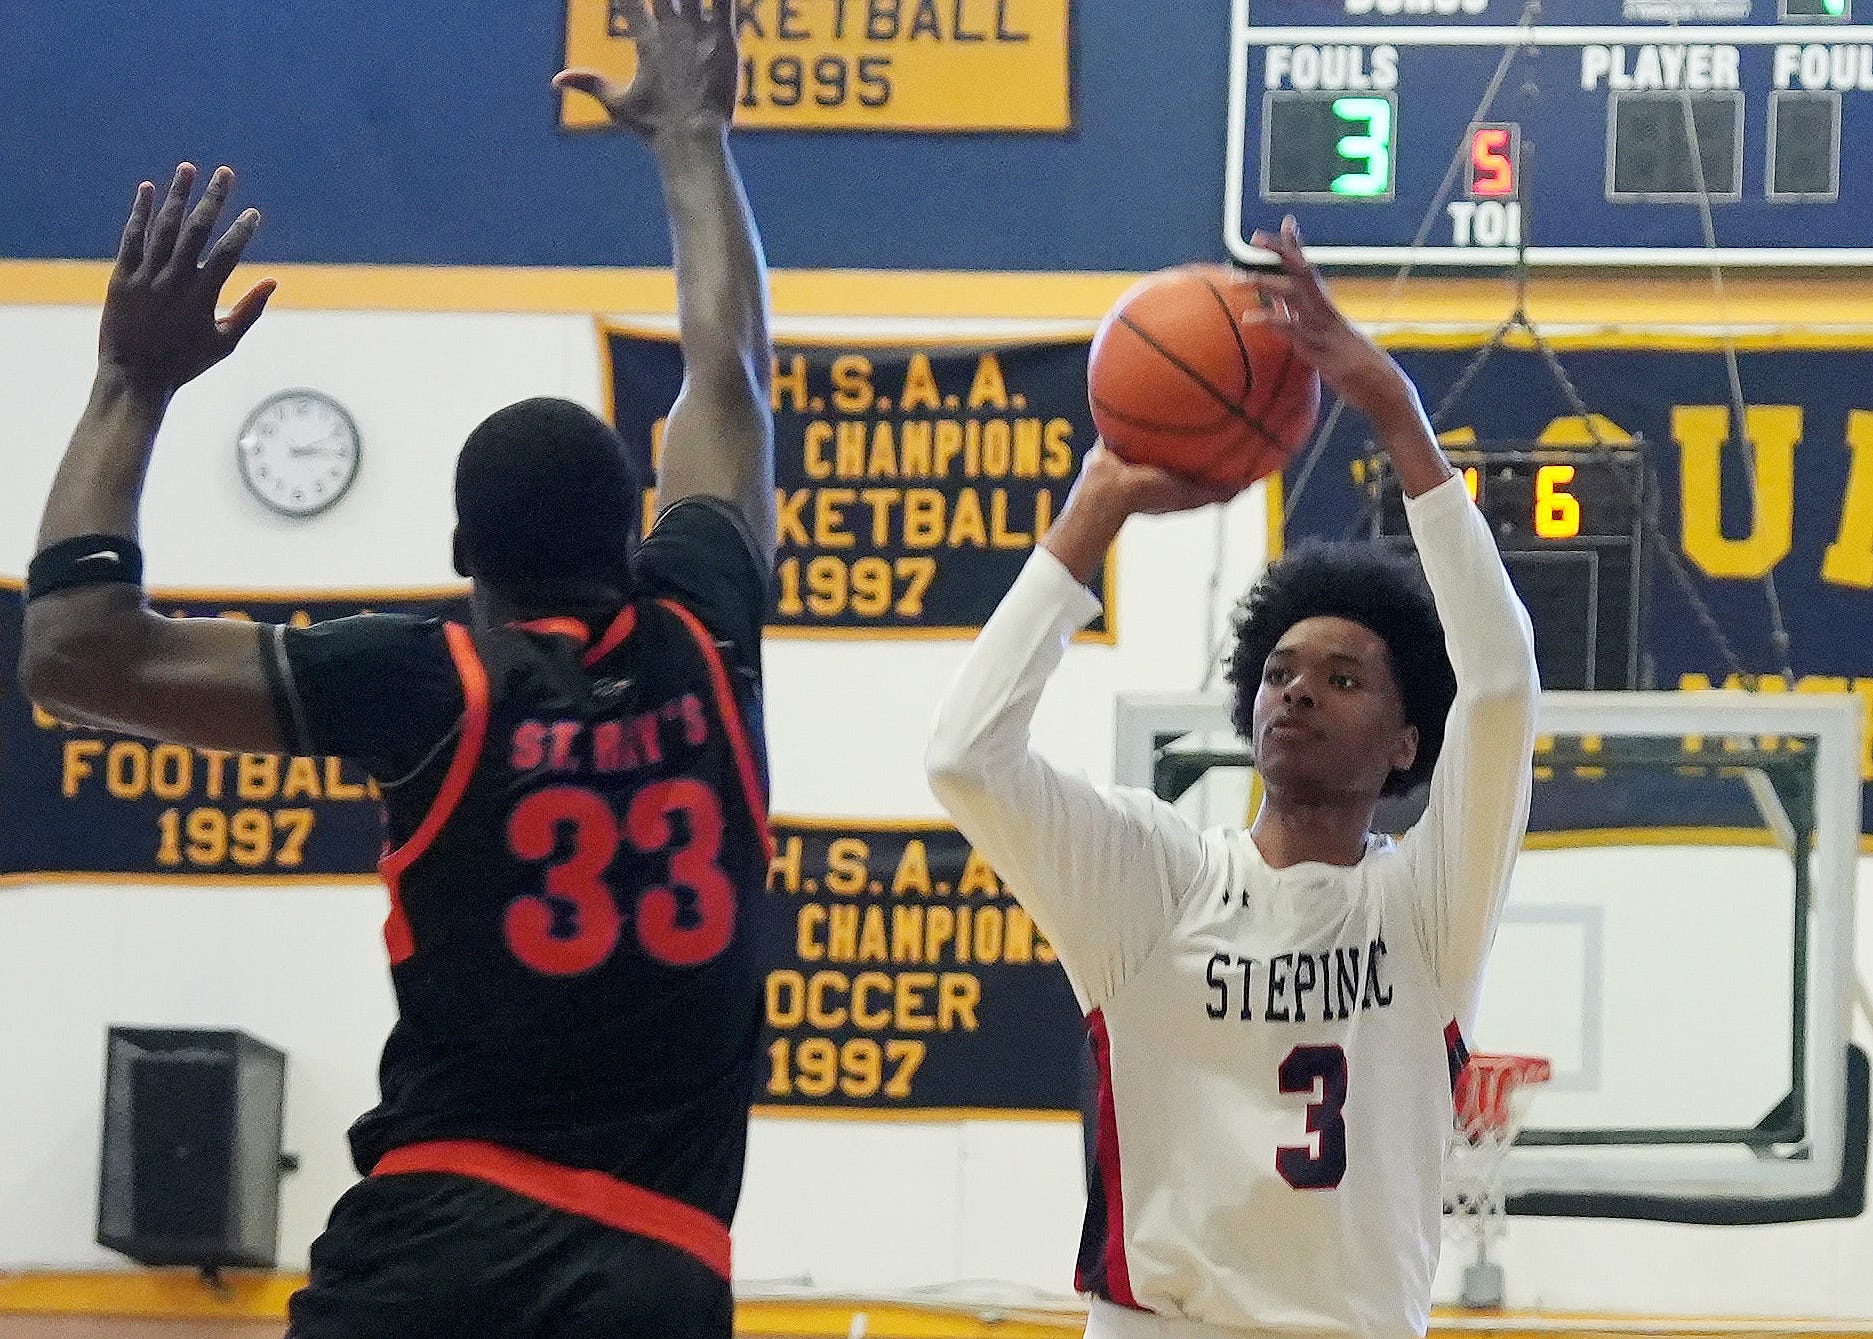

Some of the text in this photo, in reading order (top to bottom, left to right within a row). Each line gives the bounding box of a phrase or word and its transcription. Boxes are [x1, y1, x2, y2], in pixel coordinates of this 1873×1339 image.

[608, 0, 1030, 40] BKETBALL
[740, 54, 893, 107] 1995
[1264, 44, 1399, 91] FOULS
[1581, 44, 1741, 91] PLAYER
[1330, 97, 1391, 196] 3
[1472, 128, 1513, 196] 5
[803, 417, 1074, 480] CHAMPIONS
[1535, 464, 1582, 539] 6
[778, 556, 938, 617] 1997
[62, 739, 382, 799] FOOTBAL
[156, 806, 316, 867] 1997
[503, 778, 738, 976] 33
[765, 969, 981, 1032] OCCER
[766, 1036, 927, 1098] 1997
[1275, 1043, 1349, 1191] 3
